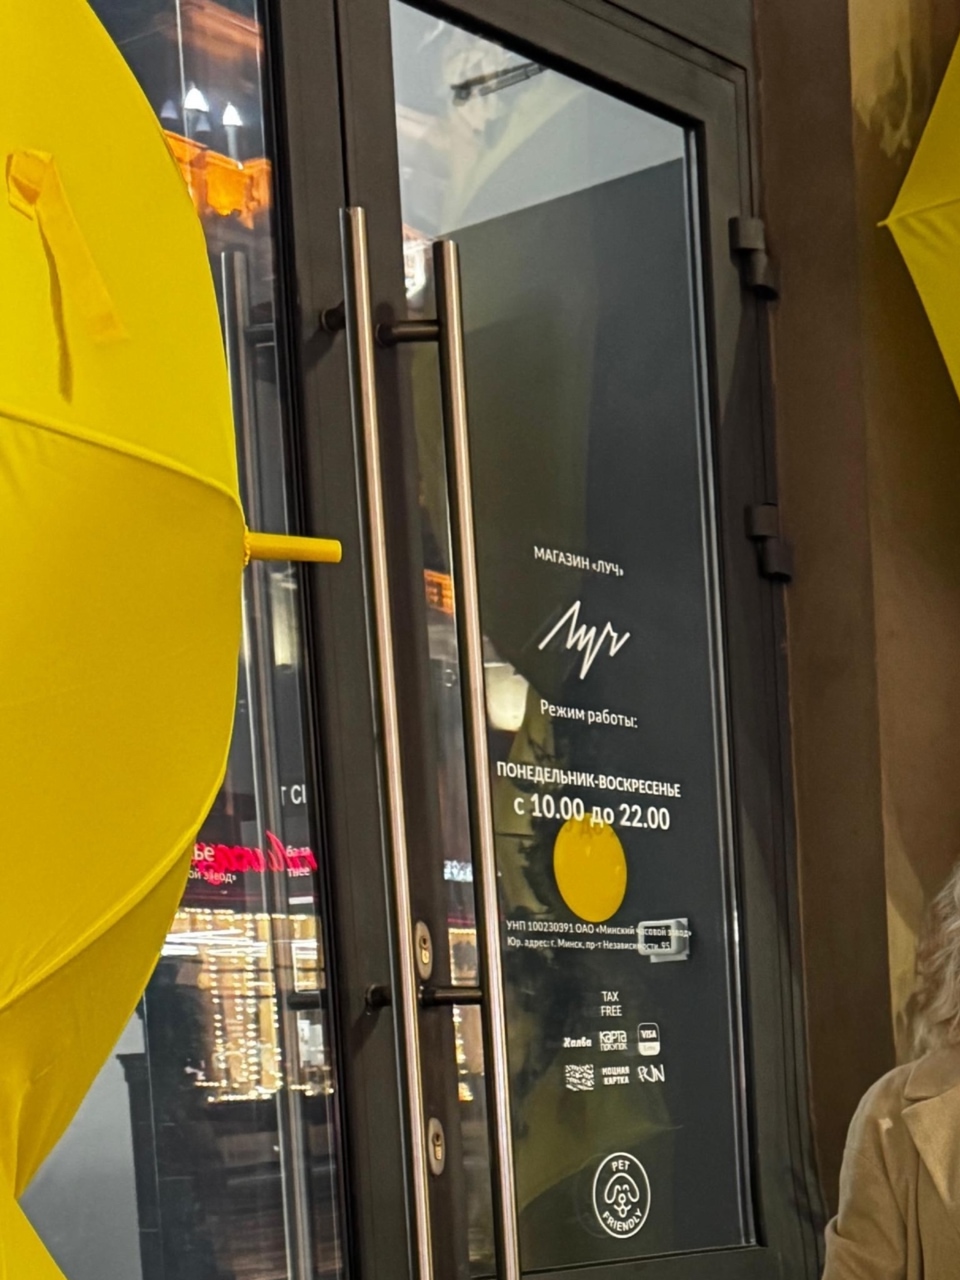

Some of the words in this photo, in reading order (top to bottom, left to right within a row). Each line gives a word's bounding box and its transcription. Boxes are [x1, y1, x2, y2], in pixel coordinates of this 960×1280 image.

[534, 545, 590, 570] МАГАЗИН
[592, 560, 624, 577] «ЛУЧ»
[540, 698, 585, 721] Режим
[587, 708, 639, 728] работы:
[496, 761, 682, 798] ПОНЕДЕЛЬНИК-ВОСКРЕСЕНЬЕ
[513, 797, 525, 815] с
[530, 793, 585, 822] 10.00
[589, 805, 615, 828] до
[619, 803, 671, 831] 22.00
[506, 919, 526, 932] УНП
[528, 921, 574, 934] 100230391
[575, 923, 594, 934] ОАО
[596, 924, 635, 936] «Минский
[506, 936, 523, 949] Юр.
[524, 938, 550, 949] адрес:
[600, 991, 620, 1003] TAX
[600, 1005, 622, 1017] FREE
[640, 1029, 657, 1039] VISA
[611, 1159, 631, 1172] PET
[602, 1207, 643, 1232] FRIENDLY
